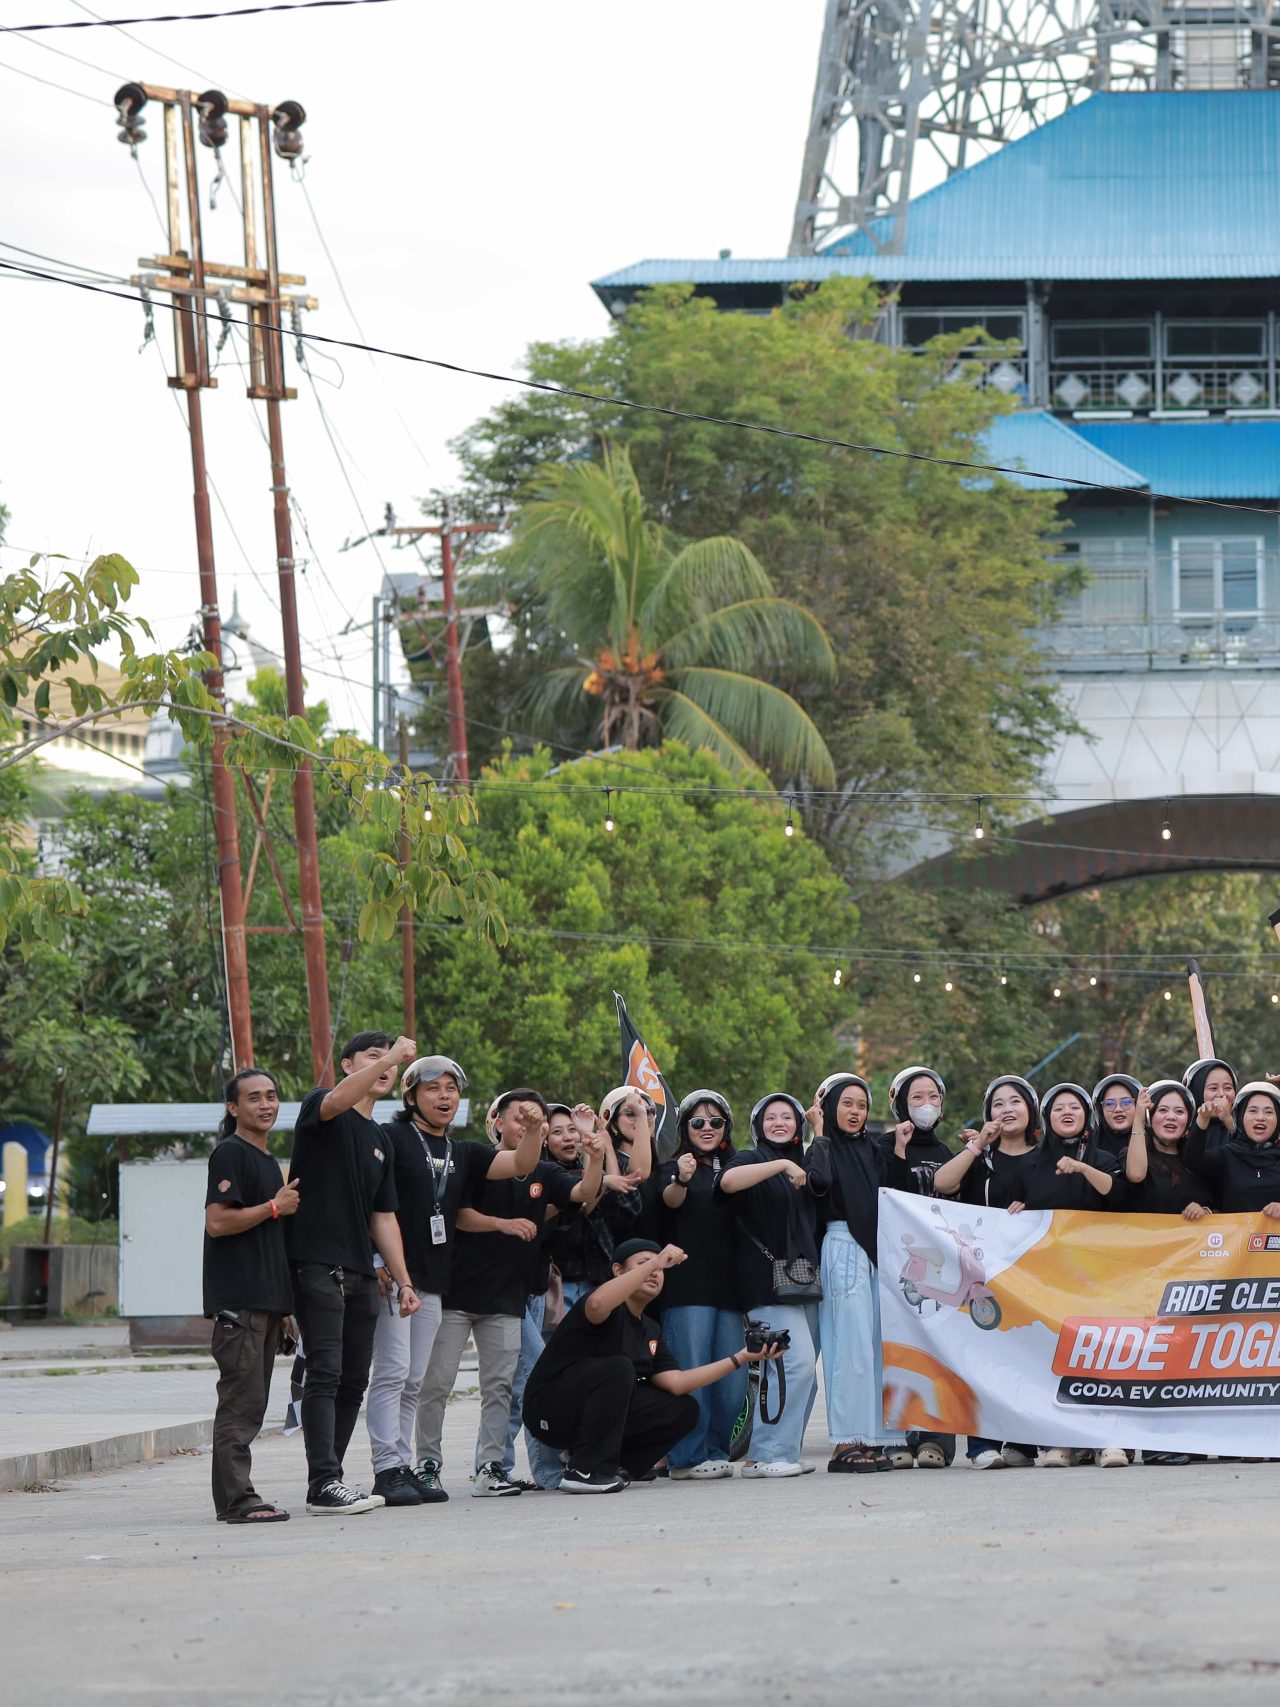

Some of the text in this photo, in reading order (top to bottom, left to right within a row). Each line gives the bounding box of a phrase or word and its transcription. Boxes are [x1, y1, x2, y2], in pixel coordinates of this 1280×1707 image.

[1199, 1249, 1230, 1257] GODA
[1165, 1284, 1227, 1312] RIDE
[1067, 1324, 1177, 1371] RIDE
[1069, 1382, 1125, 1399] GODA
[1129, 1386, 1158, 1400] EV
[1160, 1382, 1280, 1400] COMMUNITY
